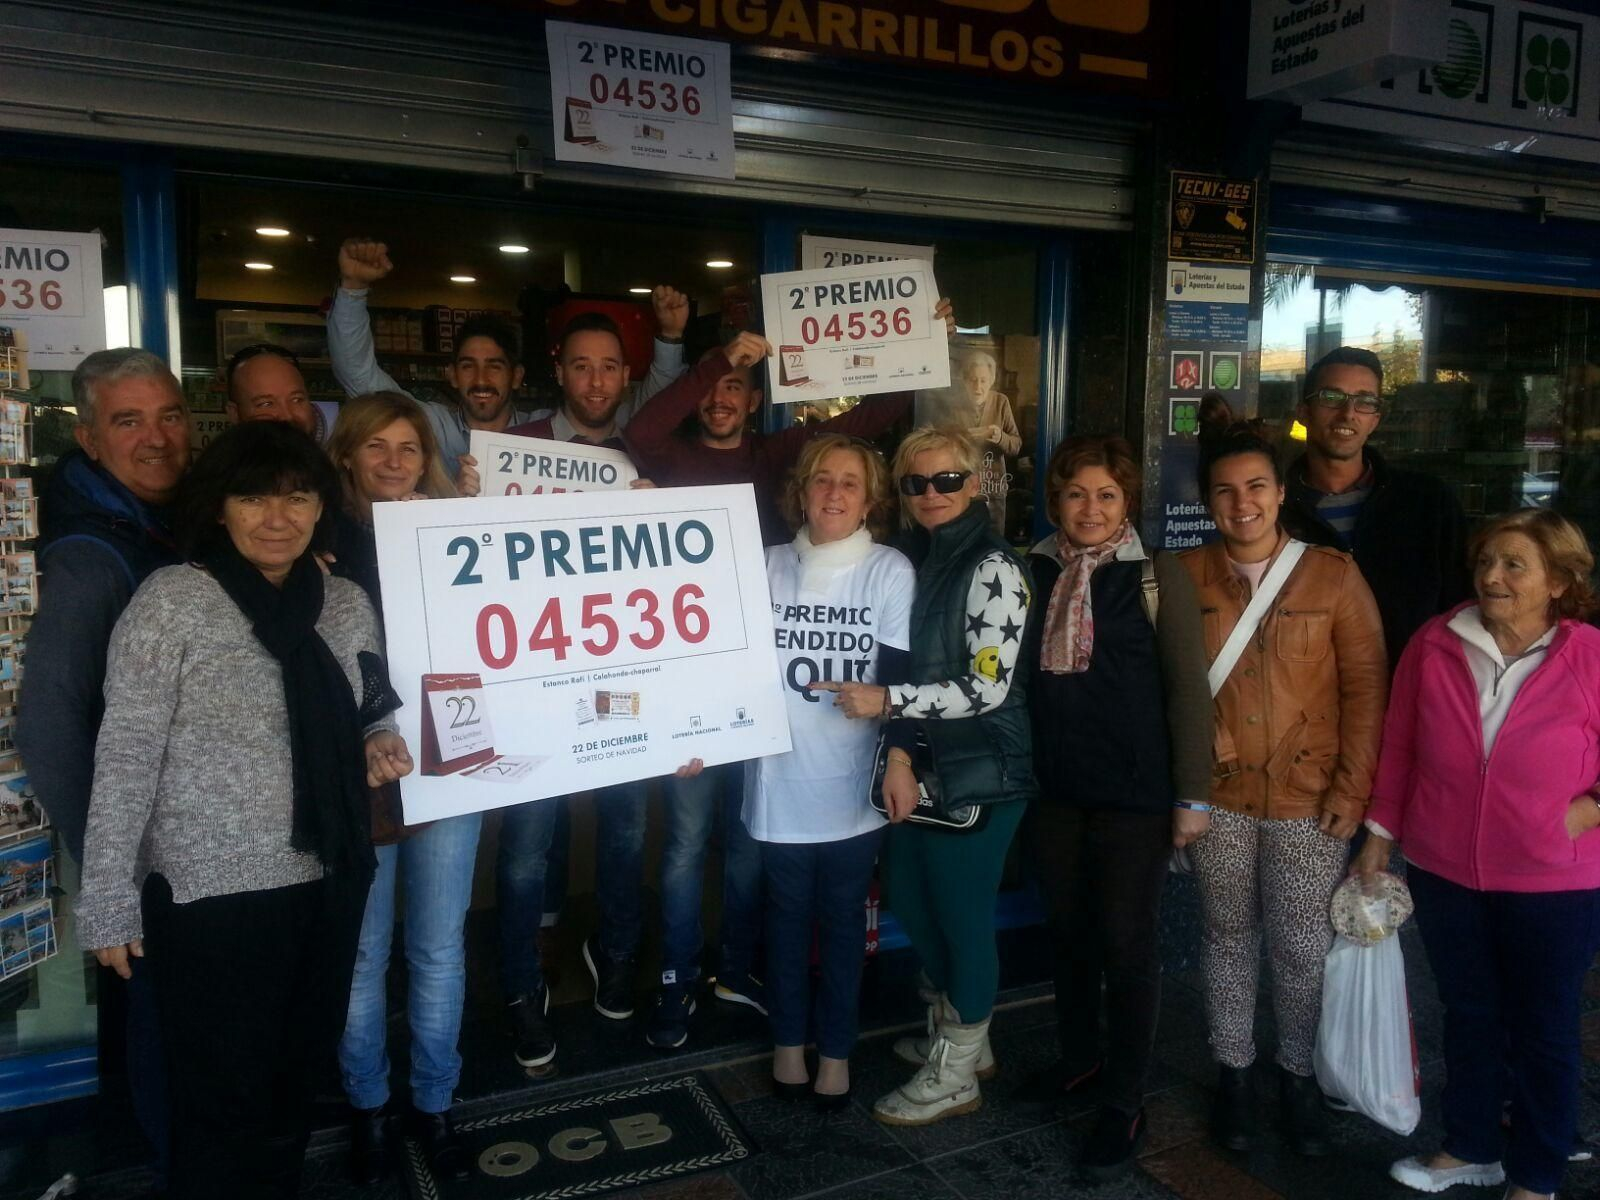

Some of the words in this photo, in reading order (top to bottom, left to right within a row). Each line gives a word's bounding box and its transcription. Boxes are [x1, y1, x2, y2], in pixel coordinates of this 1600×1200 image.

[1272, 19, 1338, 54] Apuestas
[1342, 4, 1366, 29] del
[1273, 0, 1329, 32] Loterías
[604, 44, 706, 78] PREMIO
[1271, 46, 1319, 75] Estado
[589, 73, 701, 115] 04536
[1177, 178, 1251, 200] TECNY-GES
[814, 276, 917, 308] PREMIO
[1189, 273, 1212, 281] Loterías
[1189, 281, 1215, 289] Apuestas
[801, 307, 912, 345] 04536
[523, 453, 617, 484] PREMIO
[1165, 502, 1208, 515] Lotería
[1165, 534, 1203, 547] Estado
[1166, 520, 1217, 535] Apuestas
[504, 519, 714, 581] PREMIO
[475, 583, 711, 670] 04536
[775, 628, 874, 654] ENDIDO
[542, 678, 569, 688] Estanco
[571, 676, 585, 684] Rafi
[782, 655, 871, 702] QUÍ
[445, 695, 481, 729] 22
[572, 744, 583, 754] 22
[586, 741, 598, 751] DE
[600, 732, 649, 748] DICIEMBRE
[694, 726, 722, 736] NACIONAL
[576, 753, 605, 765] SORTEO
[605, 749, 615, 758] DE
[616, 745, 647, 757] NAVIDAD
[478, 1112, 673, 1177] OCB
